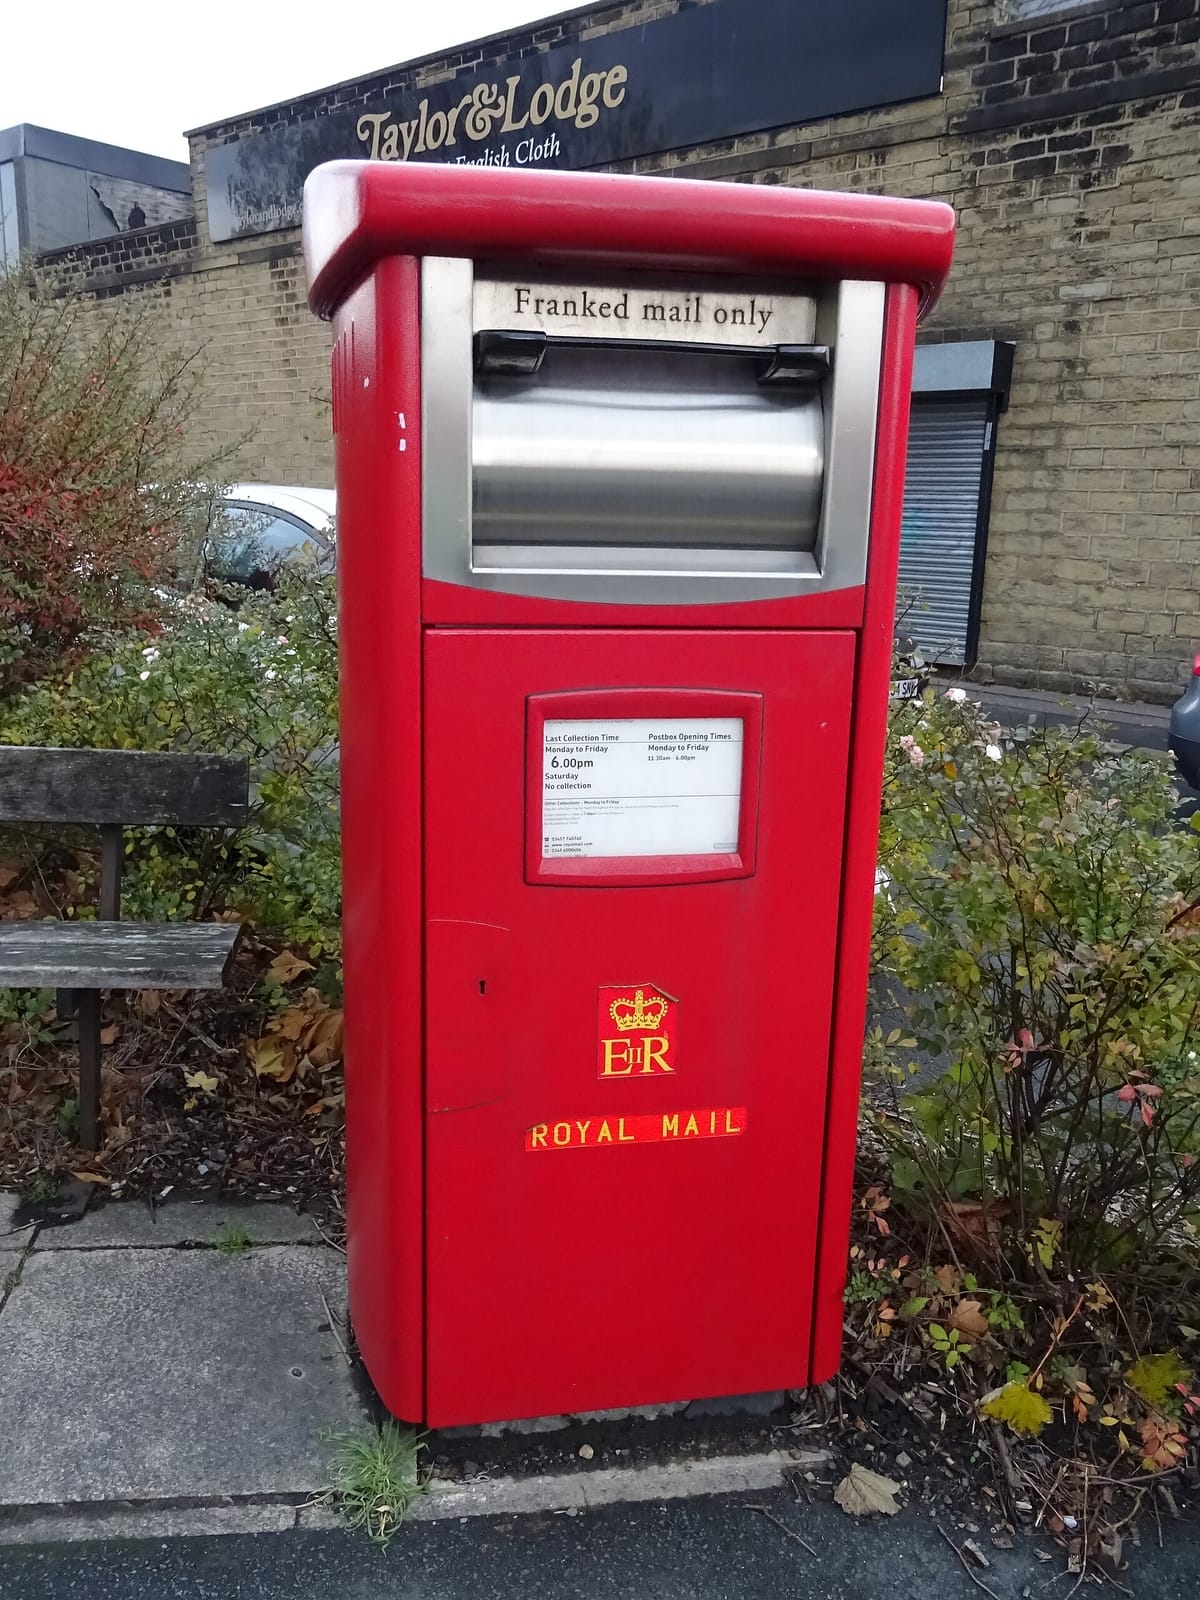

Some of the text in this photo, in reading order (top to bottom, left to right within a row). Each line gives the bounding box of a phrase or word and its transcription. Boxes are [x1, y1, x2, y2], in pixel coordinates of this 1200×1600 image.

[515, 132, 560, 164] Cloth
[514, 287, 774, 334] Franked mail only
[563, 734, 600, 742] Collection
[601, 733, 620, 741] Time
[648, 732, 732, 741] Postbox Opening Times
[545, 746, 574, 754] Monday
[585, 745, 609, 753] Friday
[648, 744, 677, 752] Monday
[686, 744, 710, 752] Friday
[551, 756, 594, 769] 6.00pm
[556, 782, 592, 790] collection
[531, 1110, 741, 1148] ROYAL MAIL
